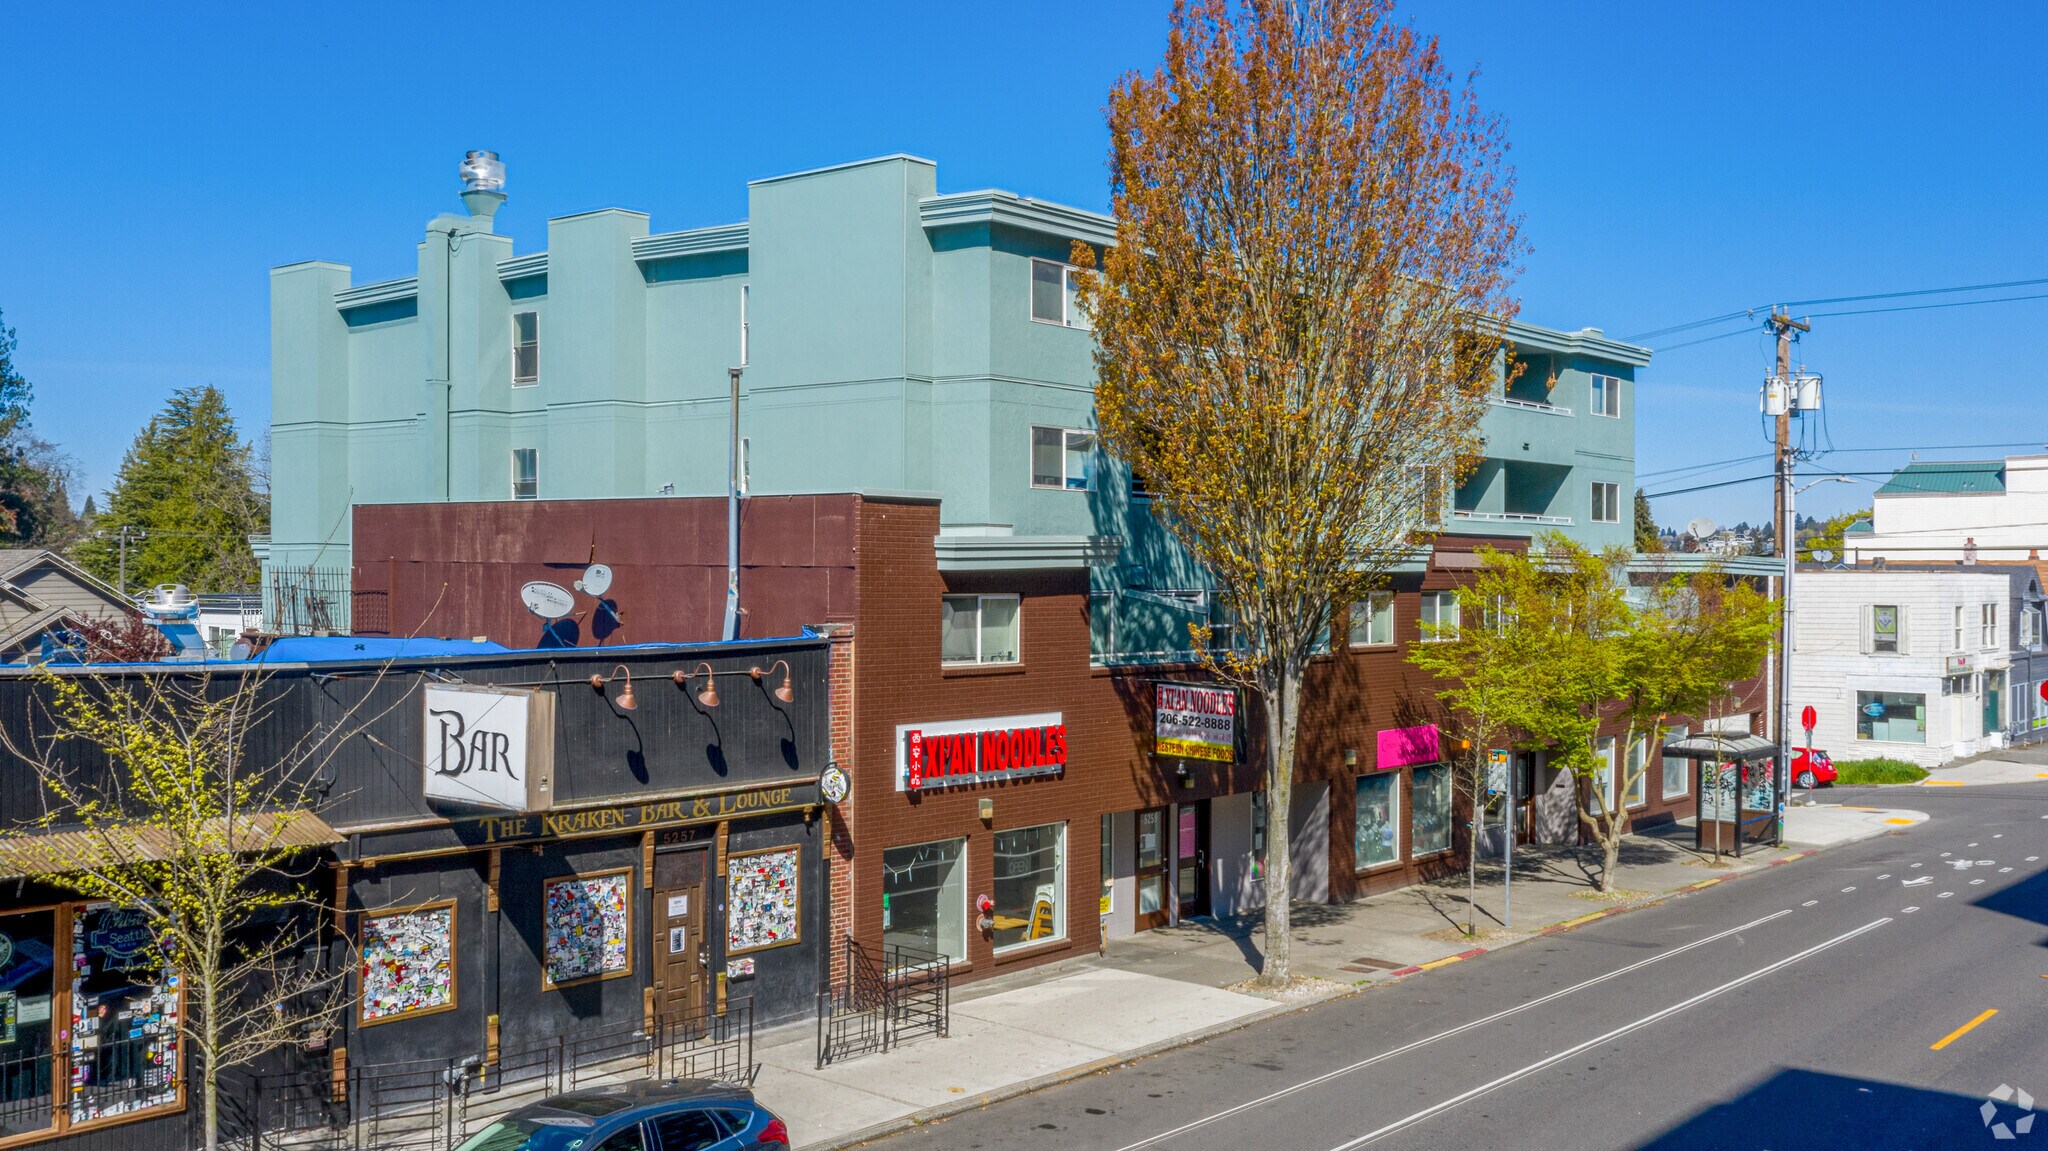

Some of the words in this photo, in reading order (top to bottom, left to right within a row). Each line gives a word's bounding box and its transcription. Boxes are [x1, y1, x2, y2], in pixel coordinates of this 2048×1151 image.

[1164, 688, 1188, 711] XI'AN
[1190, 690, 1235, 717] NOODLES
[1160, 713, 1231, 730] 206-522-8888
[429, 708, 520, 781] BAR
[911, 732, 921, 786] 西安小吃
[924, 733, 977, 779] XI'AN
[982, 724, 1067, 772] NOODLES
[1185, 744, 1212, 758] CHINESE
[1213, 748, 1234, 760] FOODS
[479, 816, 533, 843] THE
[541, 808, 625, 835] KRAKEN
[637, 801, 686, 825] BAR
[692, 798, 711, 818] &
[717, 787, 794, 815] LOUNGE
[663, 829, 697, 845] 5257
[109, 929, 150, 944] Seattle
